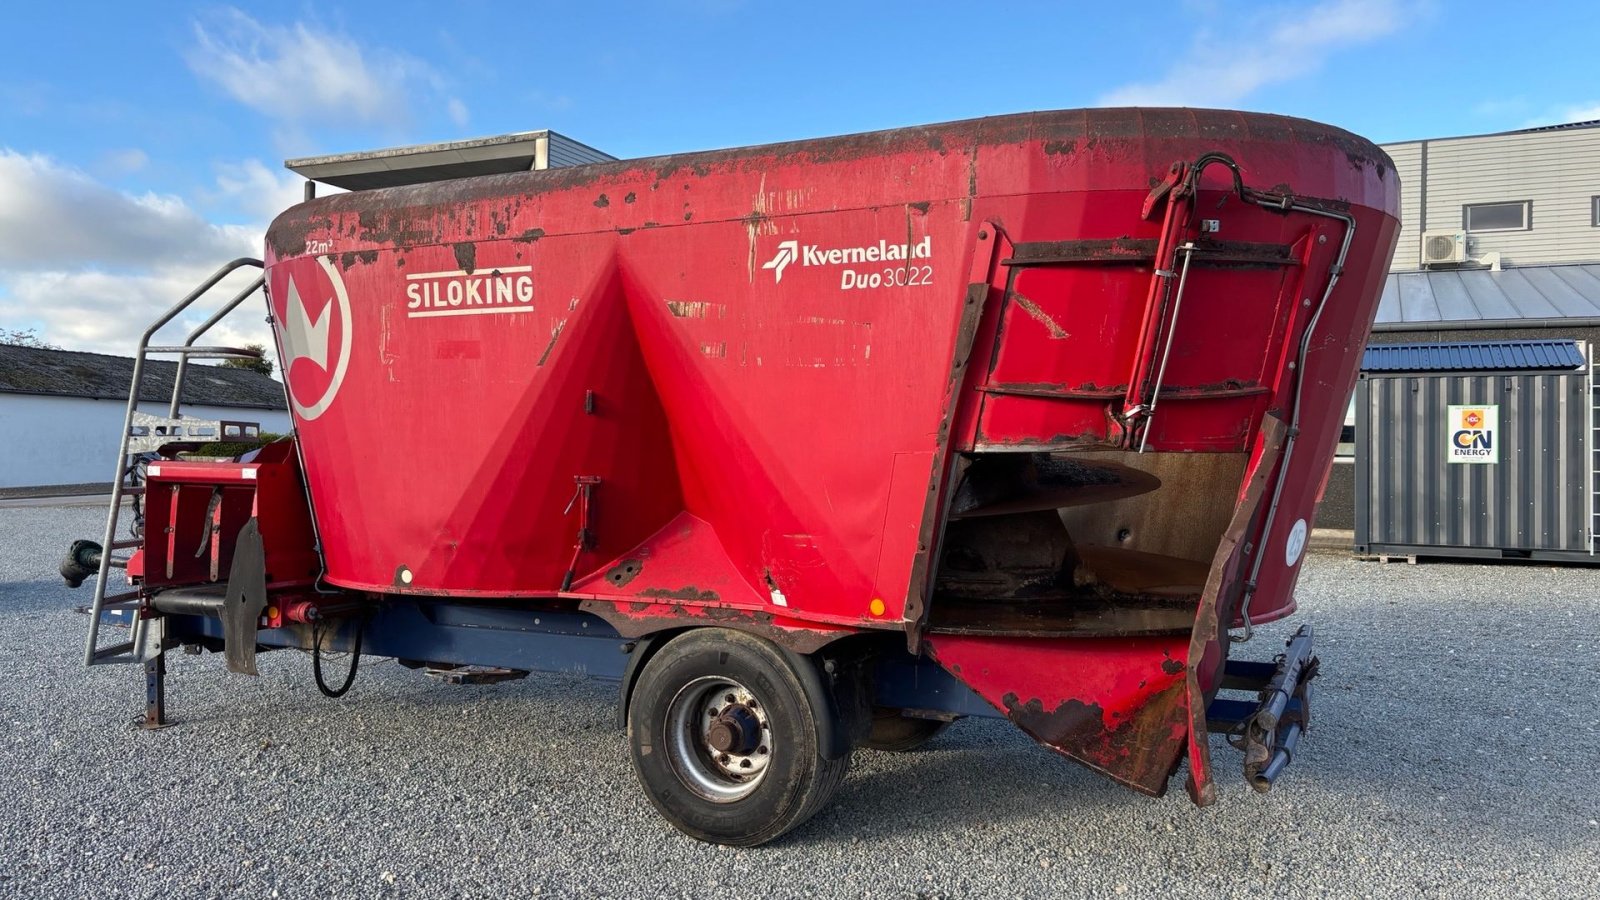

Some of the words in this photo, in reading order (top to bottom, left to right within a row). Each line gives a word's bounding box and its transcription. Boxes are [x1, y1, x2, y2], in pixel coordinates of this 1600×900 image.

[802, 235, 932, 267] Kverneland
[406, 276, 534, 309] SILOKING
[1453, 430, 1492, 449] CN
[1454, 448, 1492, 456] ENERGY
[1288, 528, 1304, 556] 25
